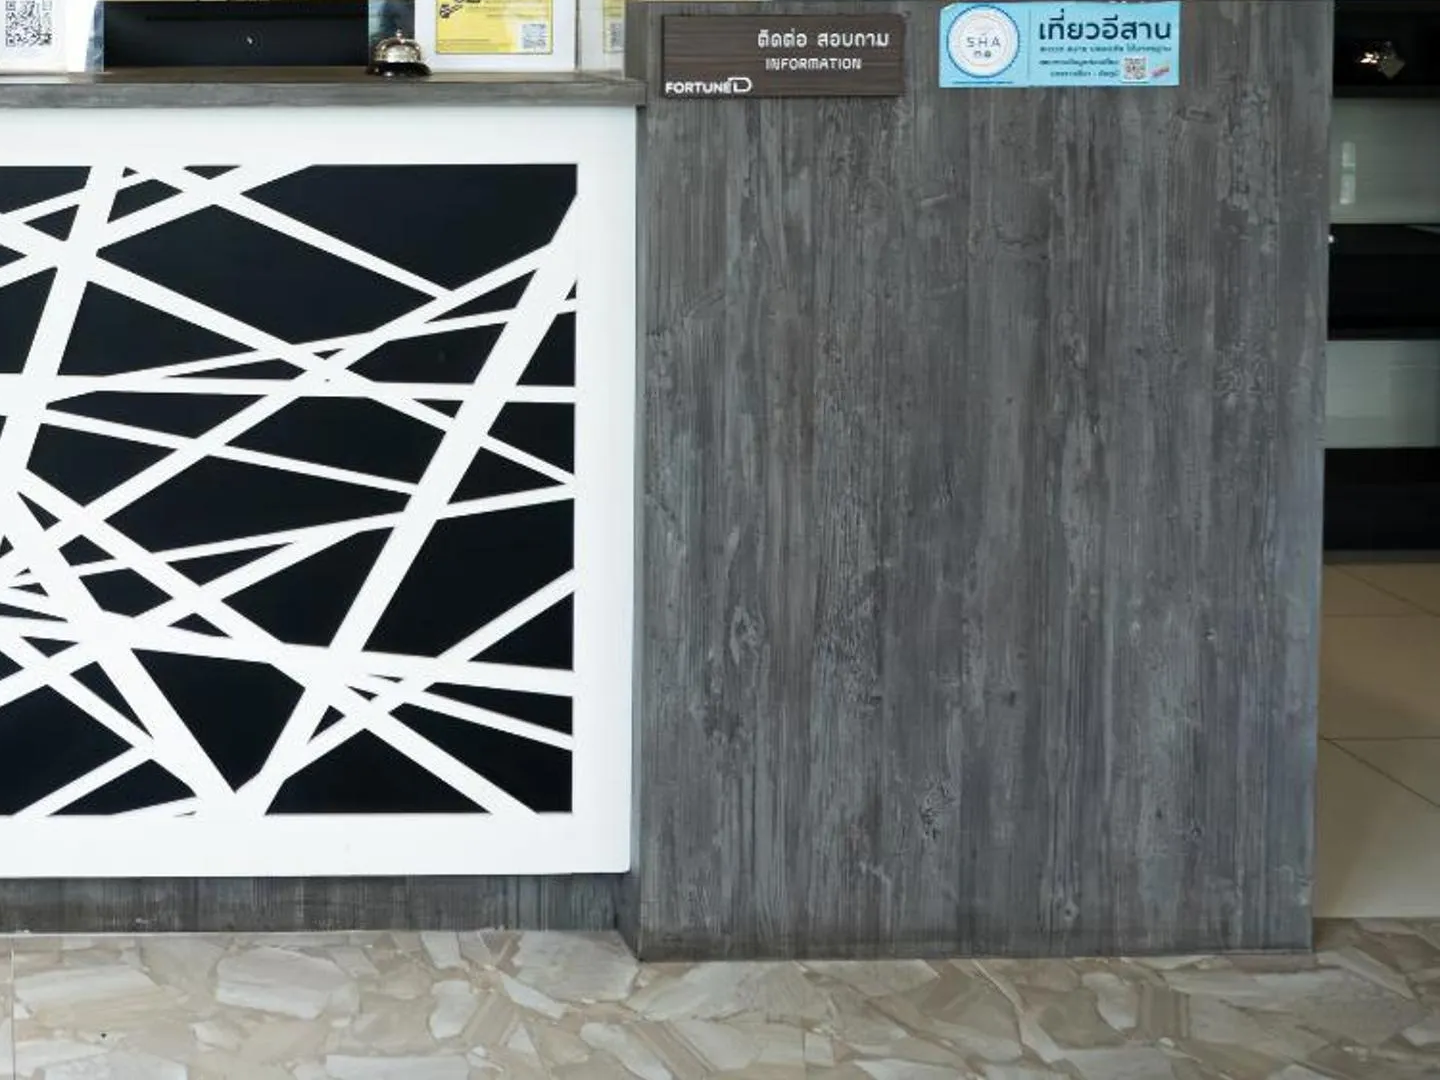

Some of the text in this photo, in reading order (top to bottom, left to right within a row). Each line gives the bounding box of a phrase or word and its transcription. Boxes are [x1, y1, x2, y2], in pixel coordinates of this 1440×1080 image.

[1039, 8, 1172, 41] เที่ยวอีสาน
[757, 28, 890, 49] ติดต่อ สอบถาม
[966, 36, 1001, 48] SHA
[765, 58, 863, 70] INFORMATION
